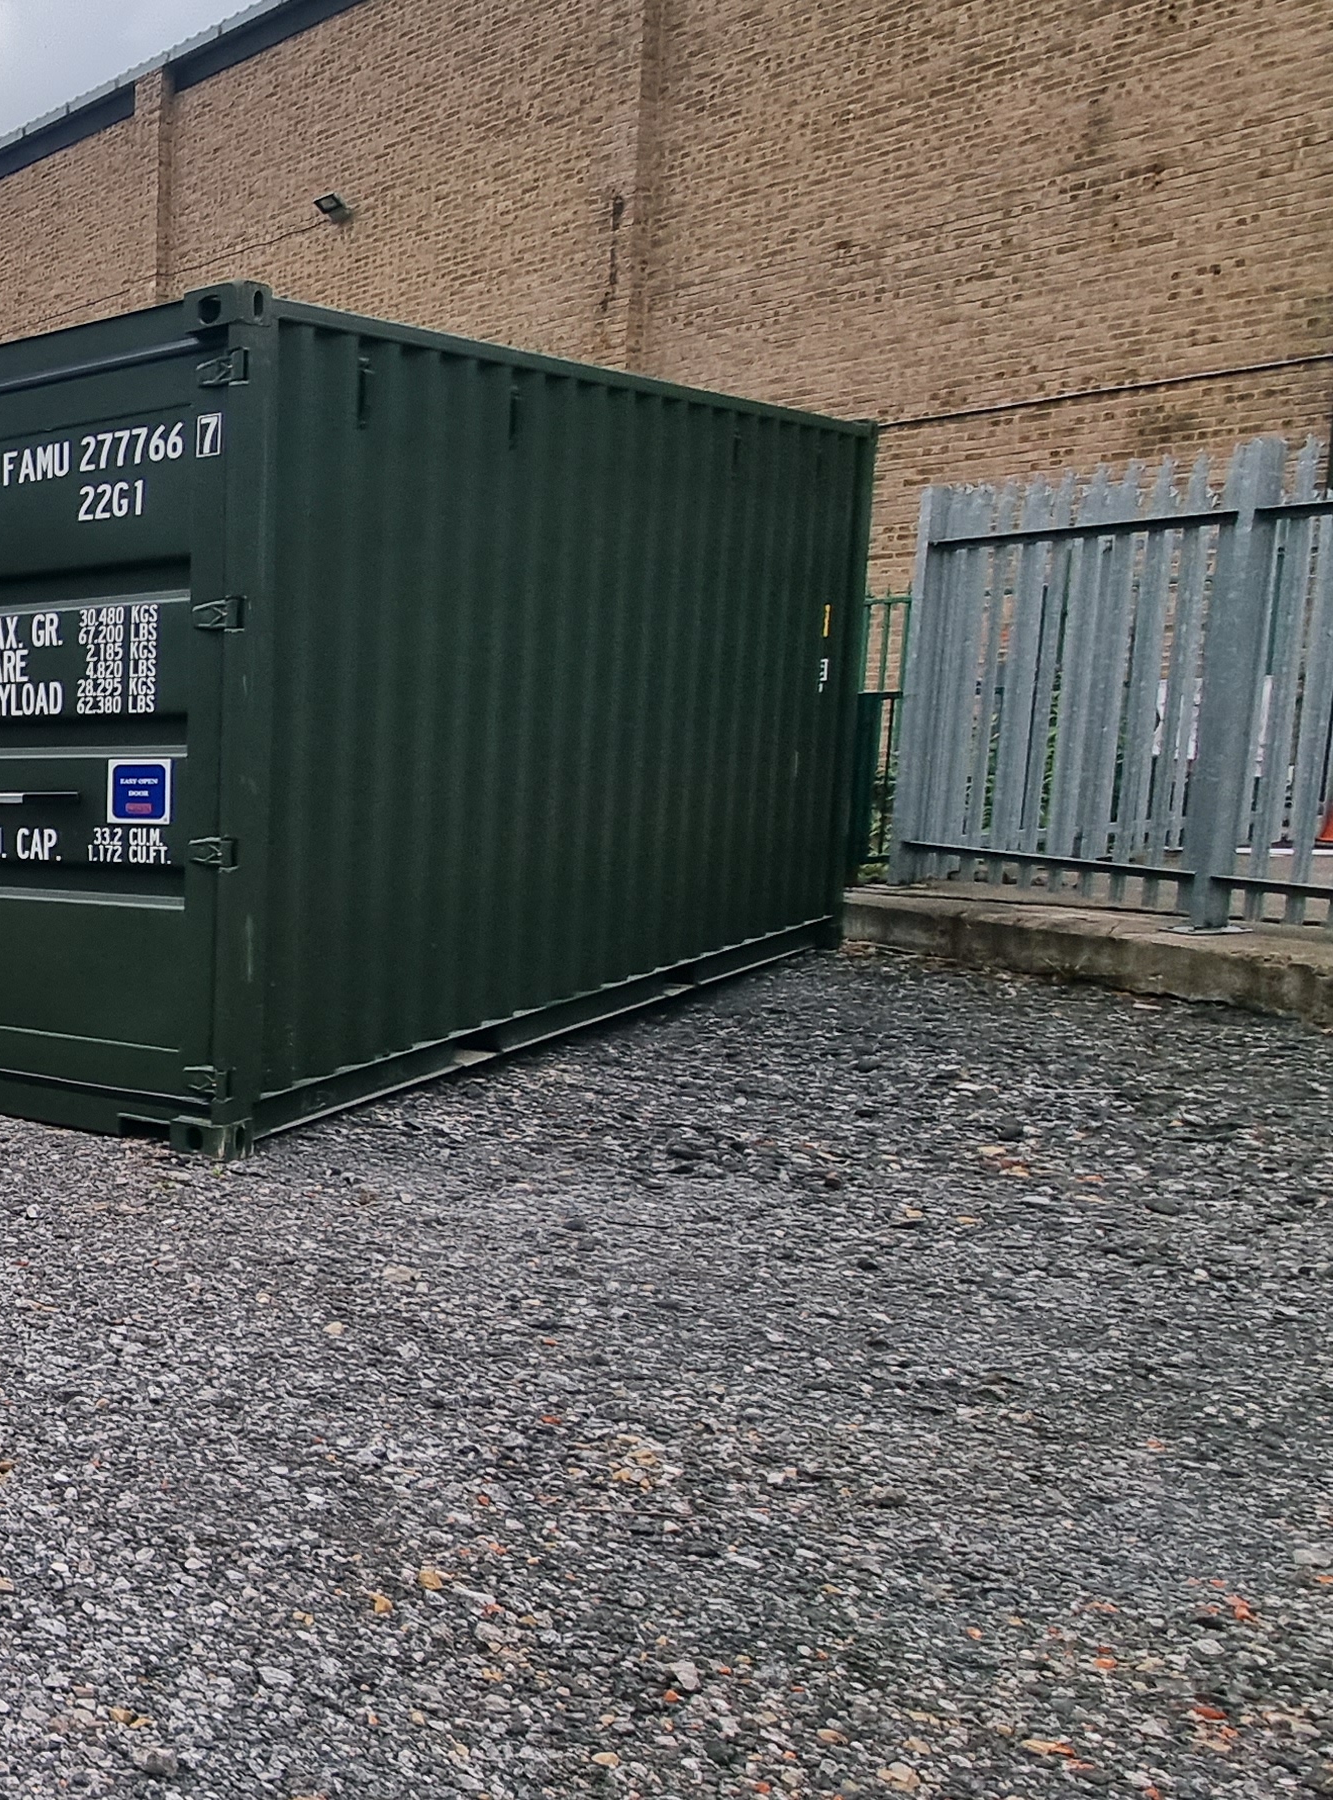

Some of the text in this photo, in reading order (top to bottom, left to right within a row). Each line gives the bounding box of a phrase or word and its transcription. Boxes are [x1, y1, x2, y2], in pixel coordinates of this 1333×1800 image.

[2, 413, 220, 487] FAMU 277766 7
[77, 479, 145, 522] 22G1
[31, 612, 64, 648] GR.
[78, 606, 125, 628] 30.480
[130, 604, 159, 624] KGS
[77, 623, 158, 644] 67.200 LBS
[85, 642, 124, 662] 2.185
[129, 641, 158, 660] KGS
[85, 659, 157, 679] 4.820 LBS
[76, 677, 123, 697] 28.295
[128, 676, 156, 695] KGS
[76, 695, 155, 715] 62.380 LBS
[15, 827, 62, 863] CAP.
[93, 826, 123, 846] 33.2
[128, 827, 164, 848] CU.M.
[87, 844, 173, 866] 1.172 CU.FT.
